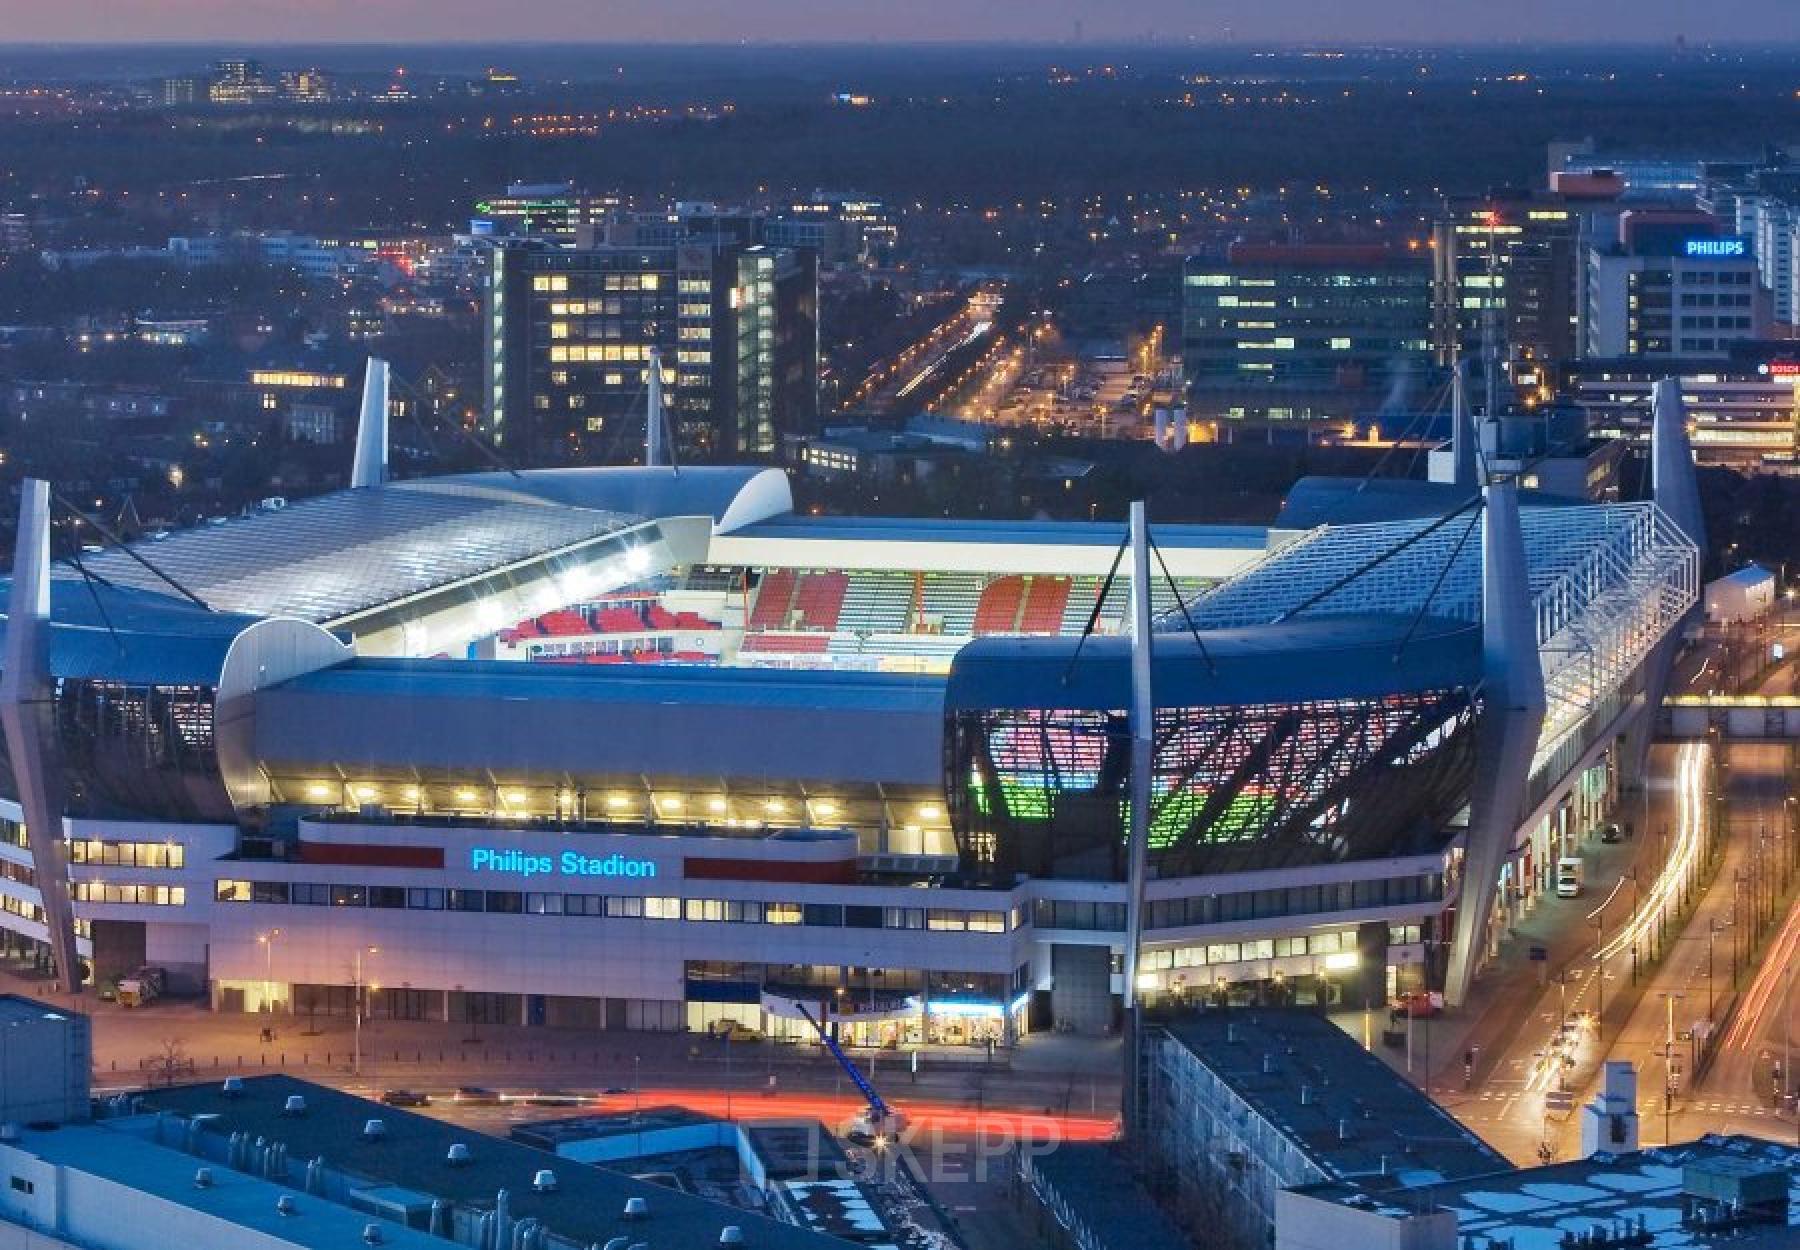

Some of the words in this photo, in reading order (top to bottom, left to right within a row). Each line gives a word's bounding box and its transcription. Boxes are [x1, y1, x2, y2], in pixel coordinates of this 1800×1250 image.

[1687, 241, 1743, 255] PHILIPS
[473, 849, 552, 877] Philips
[561, 852, 656, 877] Stadion
